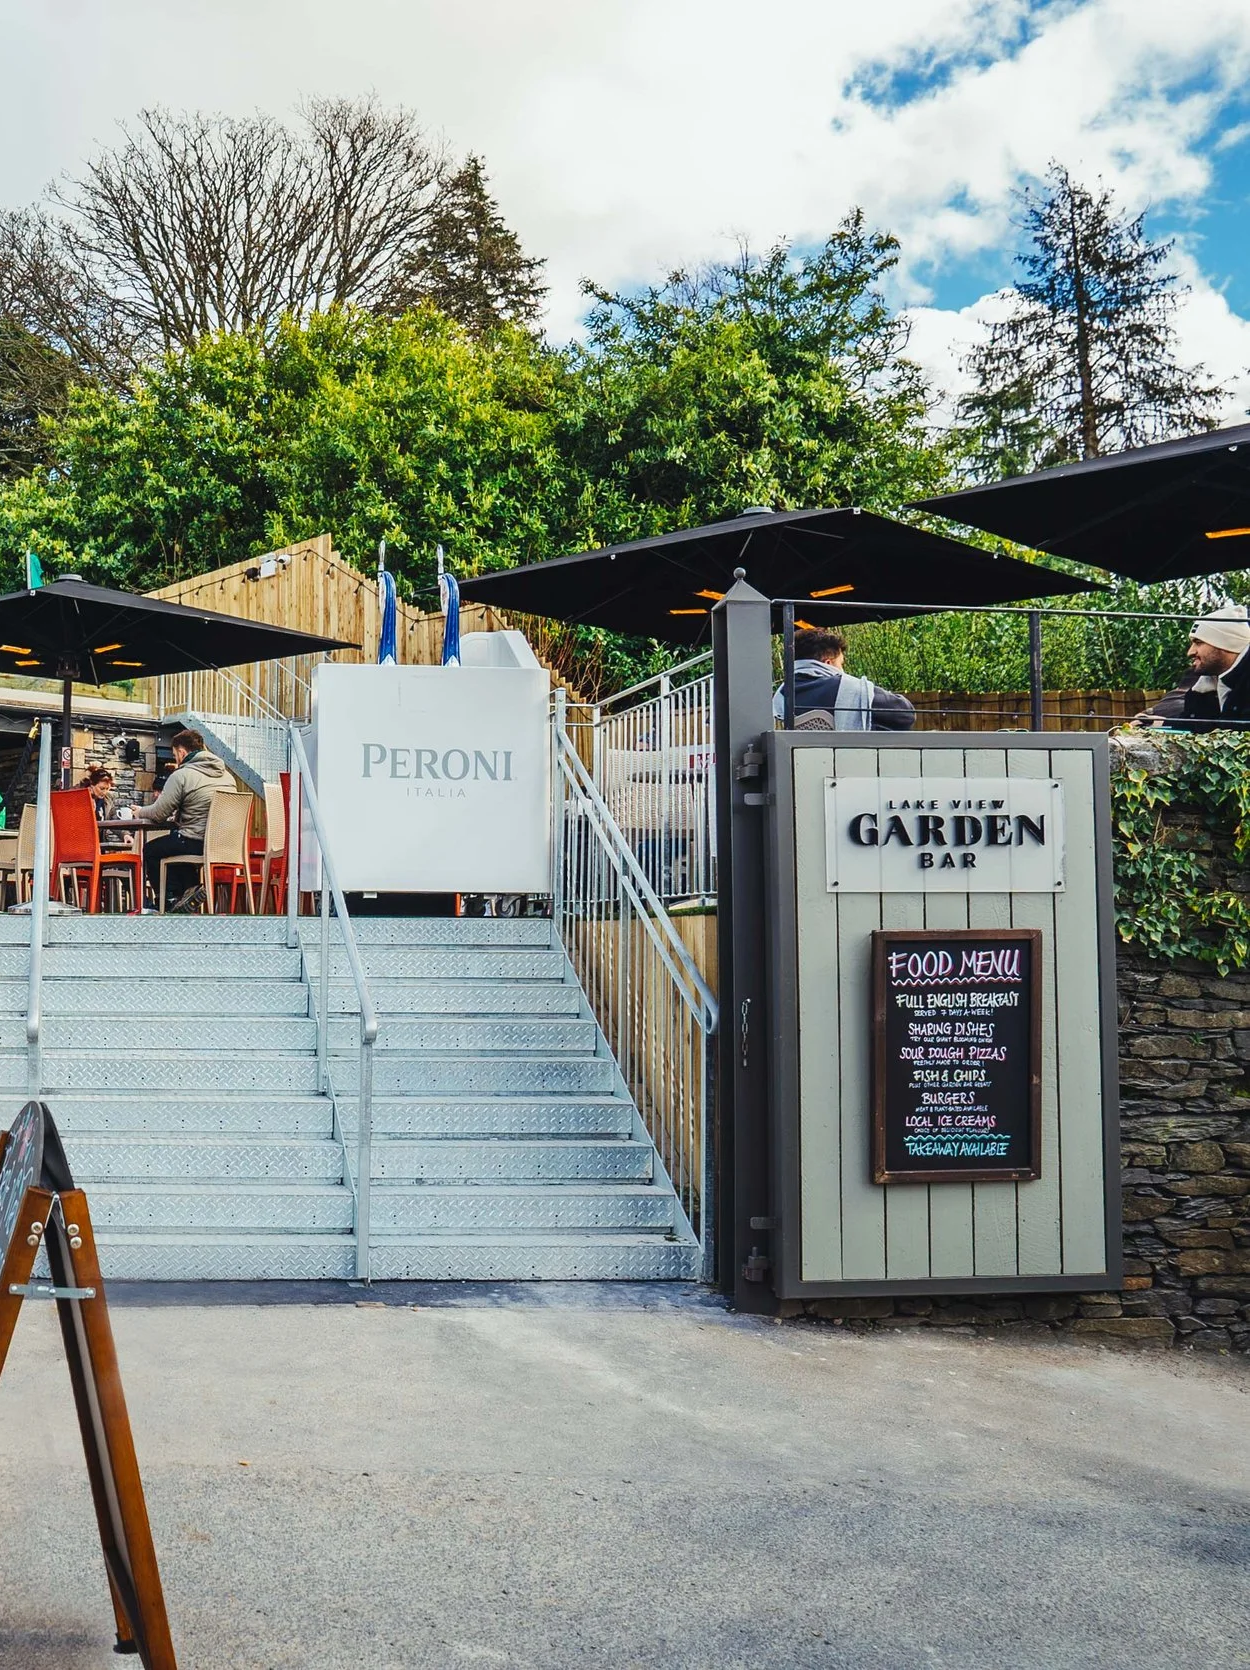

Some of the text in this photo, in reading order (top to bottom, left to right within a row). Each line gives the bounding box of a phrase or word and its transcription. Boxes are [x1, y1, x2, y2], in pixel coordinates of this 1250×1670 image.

[361, 743, 513, 781] PERONI
[407, 787, 466, 798] ITALIA
[888, 799, 1005, 810] LAKE VIEW
[849, 813, 1045, 847] GARDEN
[920, 852, 976, 869] BAR
[888, 949, 1021, 978] FOOD MENU
[895, 991, 1019, 1009] FULL ENGLISH BREAKFAST
[914, 1009, 937, 1017] SERVED
[908, 1021, 995, 1038] SHARING DISHES
[899, 1046, 1007, 1061] SOUR DOUGH PIZZAS
[913, 1069, 986, 1082] FISH & CHIPS
[921, 1091, 975, 1105] BURGERS
[905, 1114, 997, 1130] LOCAL ICE CREAMS
[905, 1142, 1010, 1157] TAKEAWAY AVAILABLE
